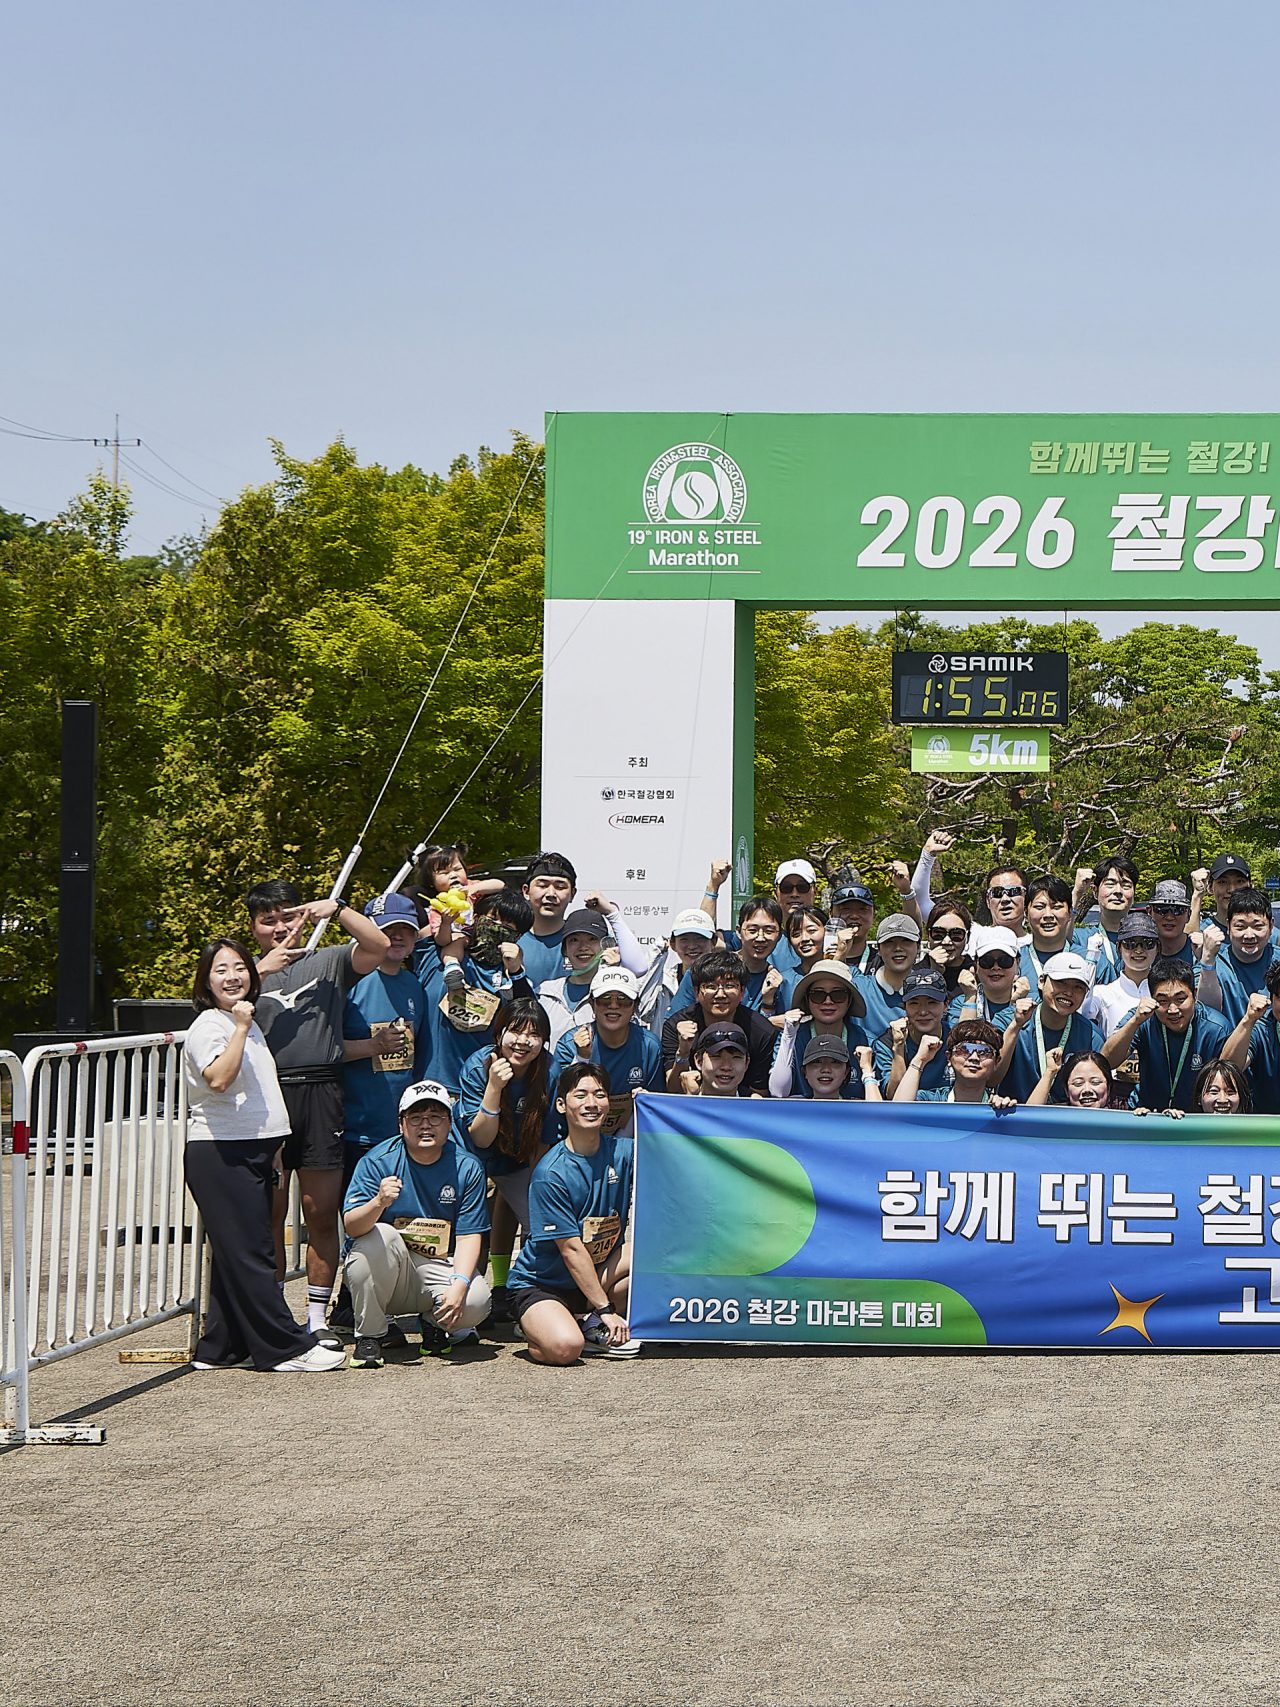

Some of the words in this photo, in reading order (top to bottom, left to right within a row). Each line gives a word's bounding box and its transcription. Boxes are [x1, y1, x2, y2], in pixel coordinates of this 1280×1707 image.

[1029, 441, 1171, 475] 함께뛰는
[1187, 441, 1270, 474] 철강!
[646, 484, 664, 522] KOREA
[714, 454, 743, 523] ASSOCIATION
[628, 530, 652, 545] 19th
[656, 530, 693, 545] IRON
[698, 530, 710, 545] &
[715, 530, 762, 545] STEEL
[857, 496, 1075, 569] 2026
[649, 549, 739, 566] Marathon
[950, 656, 1034, 672] SAMIK
[968, 734, 1039, 766] 5km
[628, 756, 649, 768] 주최
[617, 789, 675, 800] 한국철강협회
[616, 815, 665, 824] KOMERA
[625, 868, 646, 881] 후원
[623, 905, 670, 916] 산업통상부
[878, 1170, 1017, 1243] 함께
[1037, 1172, 1180, 1245] 뛰는
[669, 1297, 740, 1324] 2026
[747, 1298, 800, 1325] 철강
[806, 1300, 884, 1327] 마라톤
[892, 1302, 942, 1328] 대회
